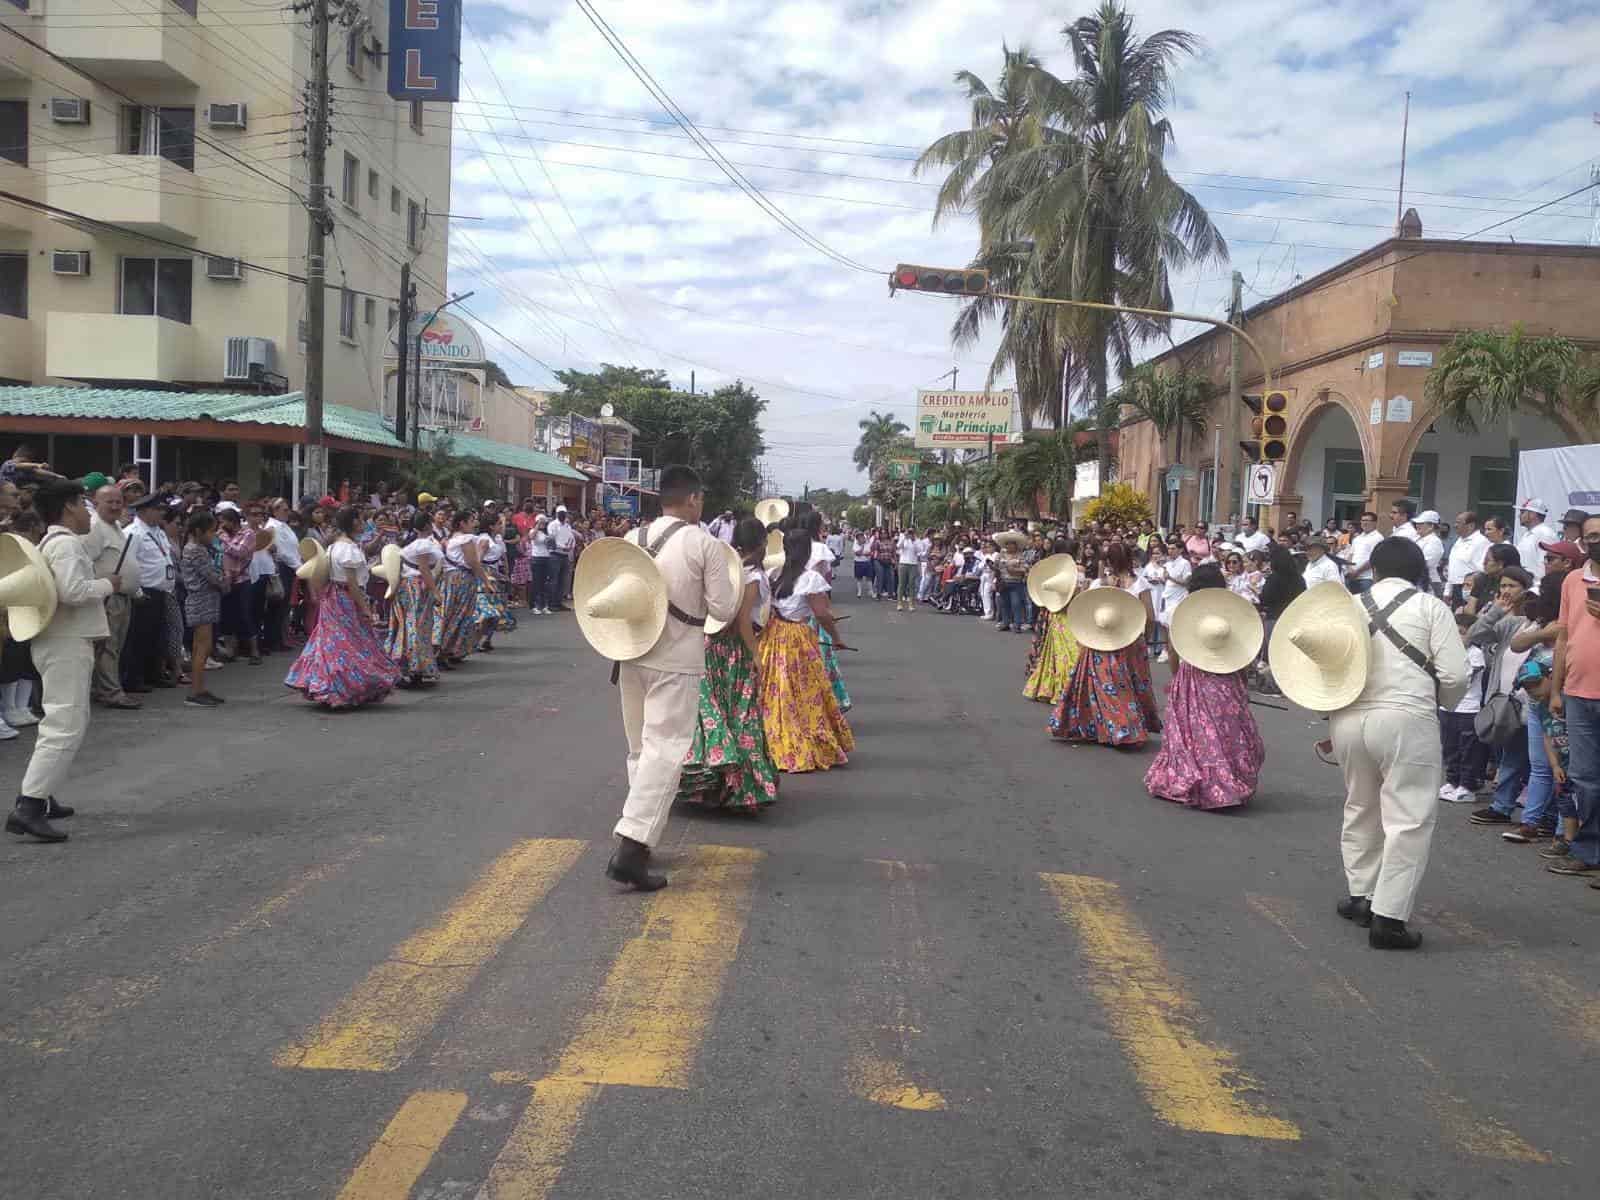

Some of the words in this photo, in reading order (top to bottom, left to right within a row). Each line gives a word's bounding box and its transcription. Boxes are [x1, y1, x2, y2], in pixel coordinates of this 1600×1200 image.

[923, 395, 966, 406] CREDITO
[968, 395, 1009, 407] AMPLIO
[938, 420, 952, 432] La
[955, 420, 1008, 433] Principal
